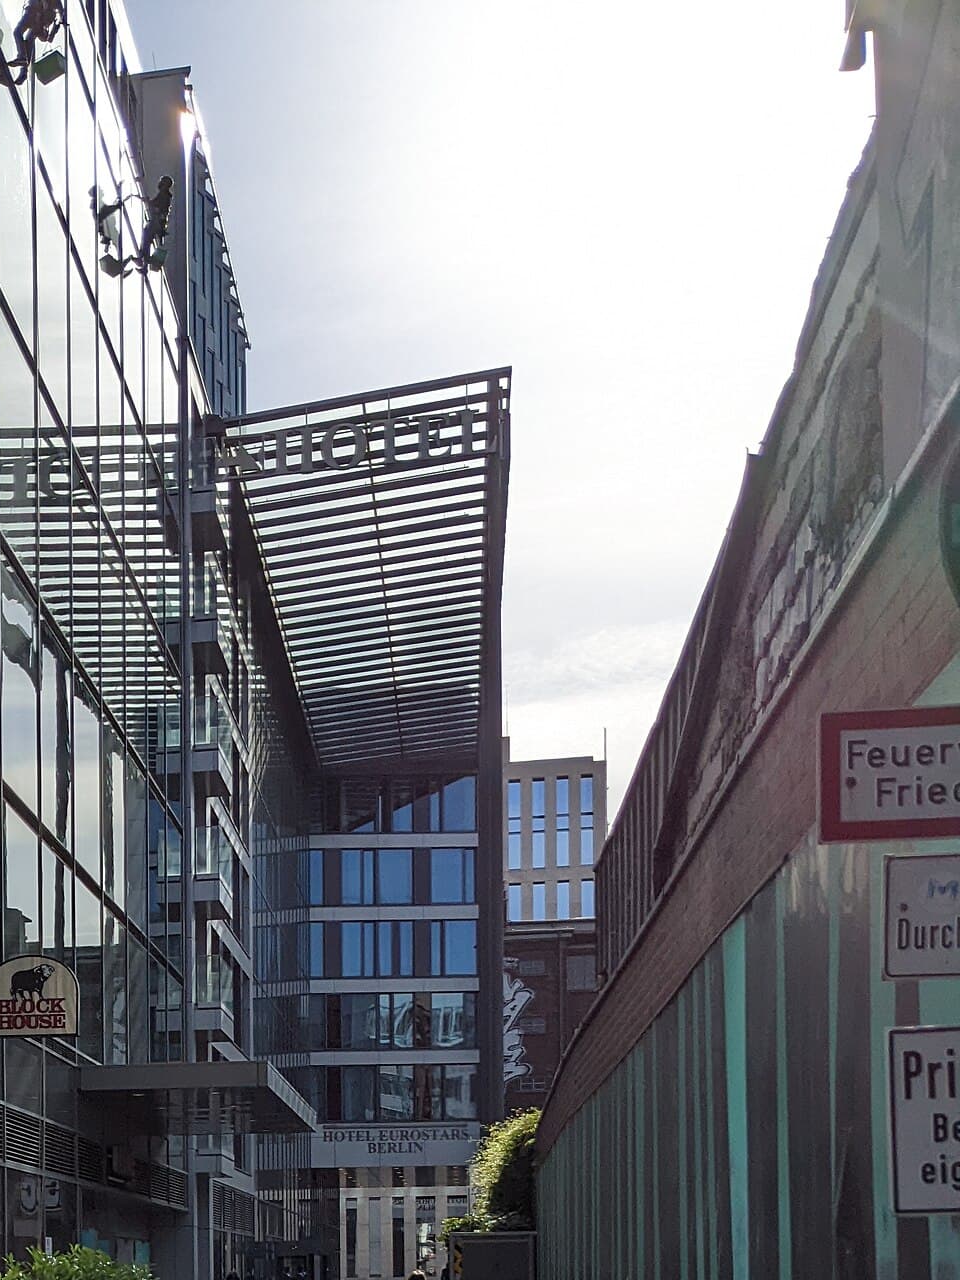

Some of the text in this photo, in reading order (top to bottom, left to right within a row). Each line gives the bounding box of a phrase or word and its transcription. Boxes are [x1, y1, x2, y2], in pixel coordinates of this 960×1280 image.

[897, 916, 960, 950] Durc
[323, 1128, 469, 1143] HOTEL EUROSTARS
[367, 1141, 424, 1154] BERLIN
